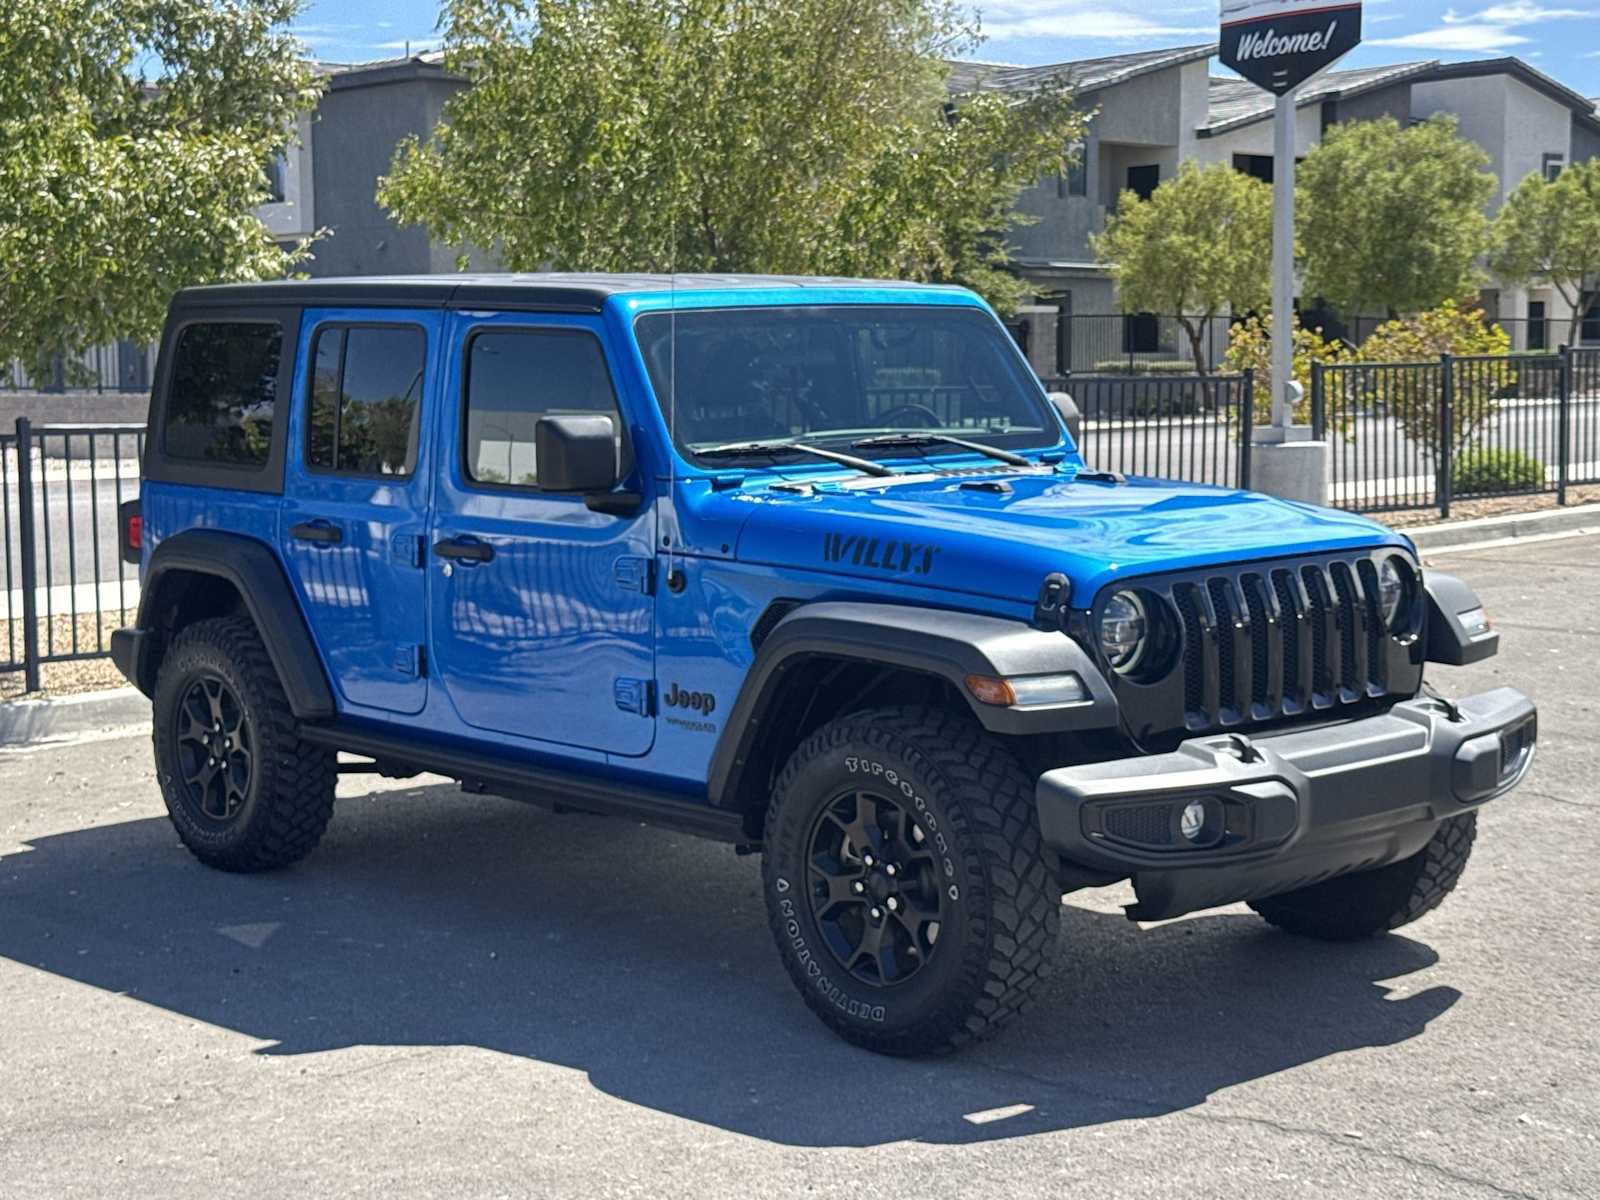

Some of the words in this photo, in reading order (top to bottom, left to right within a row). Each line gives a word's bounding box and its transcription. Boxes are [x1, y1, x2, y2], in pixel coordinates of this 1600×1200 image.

[1236, 20, 1337, 61] Welcome!
[823, 531, 942, 576] WILLYS
[664, 682, 716, 716] Jeep
